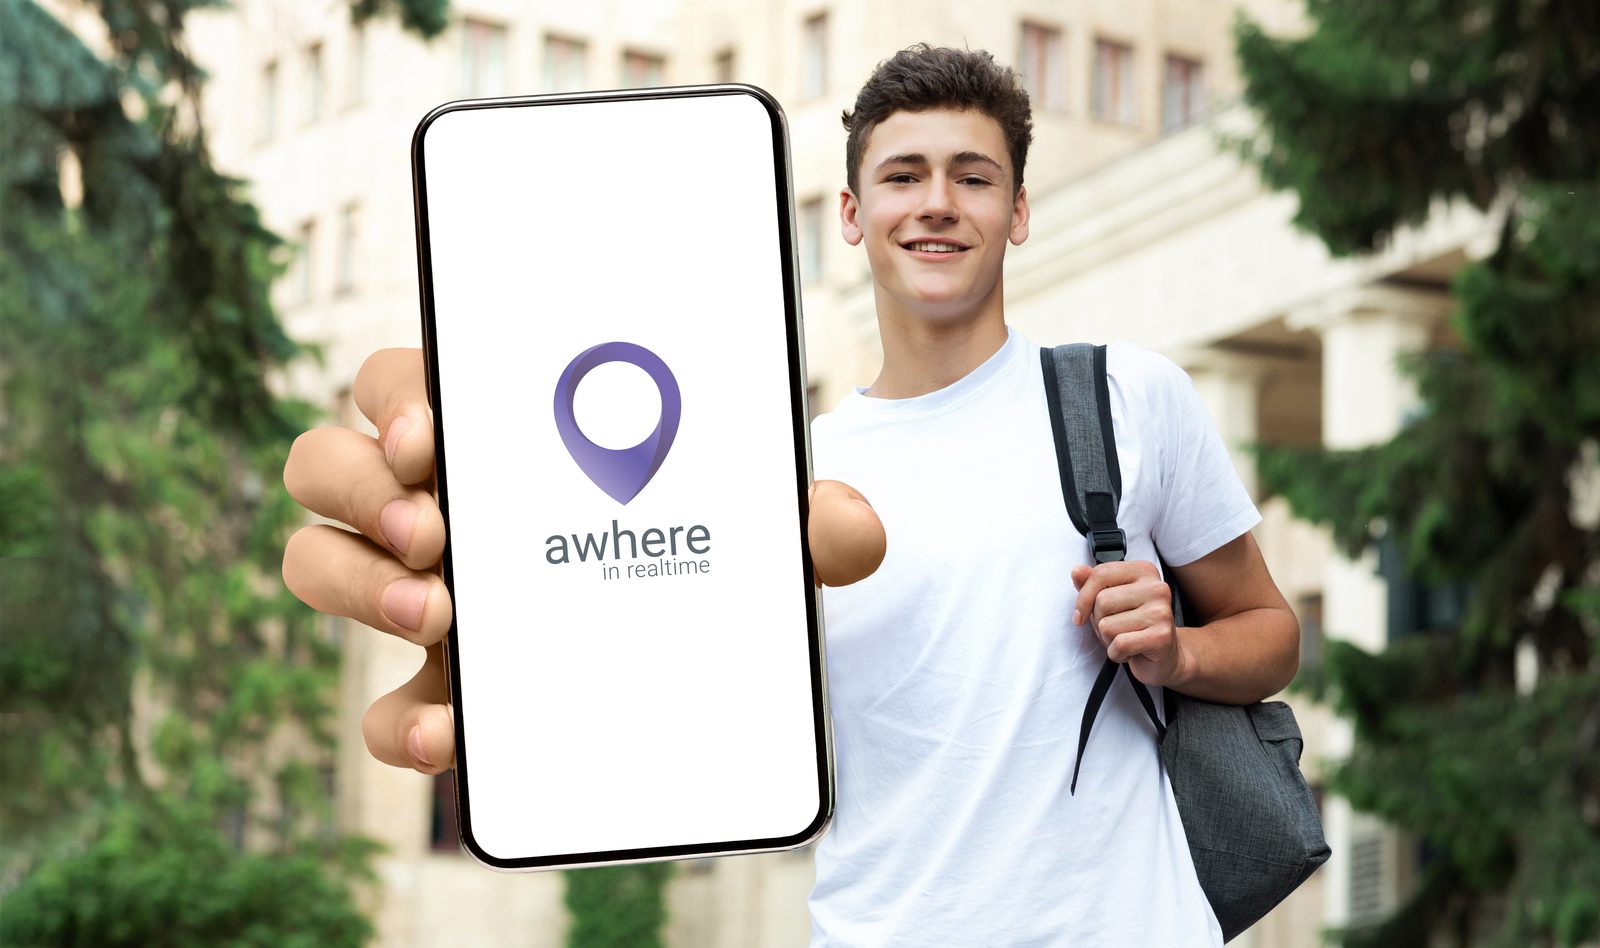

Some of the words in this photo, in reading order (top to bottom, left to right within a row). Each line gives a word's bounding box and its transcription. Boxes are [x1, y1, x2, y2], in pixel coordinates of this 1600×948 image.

[545, 519, 711, 565] awhere
[603, 562, 620, 581] in
[627, 558, 711, 579] realtime
